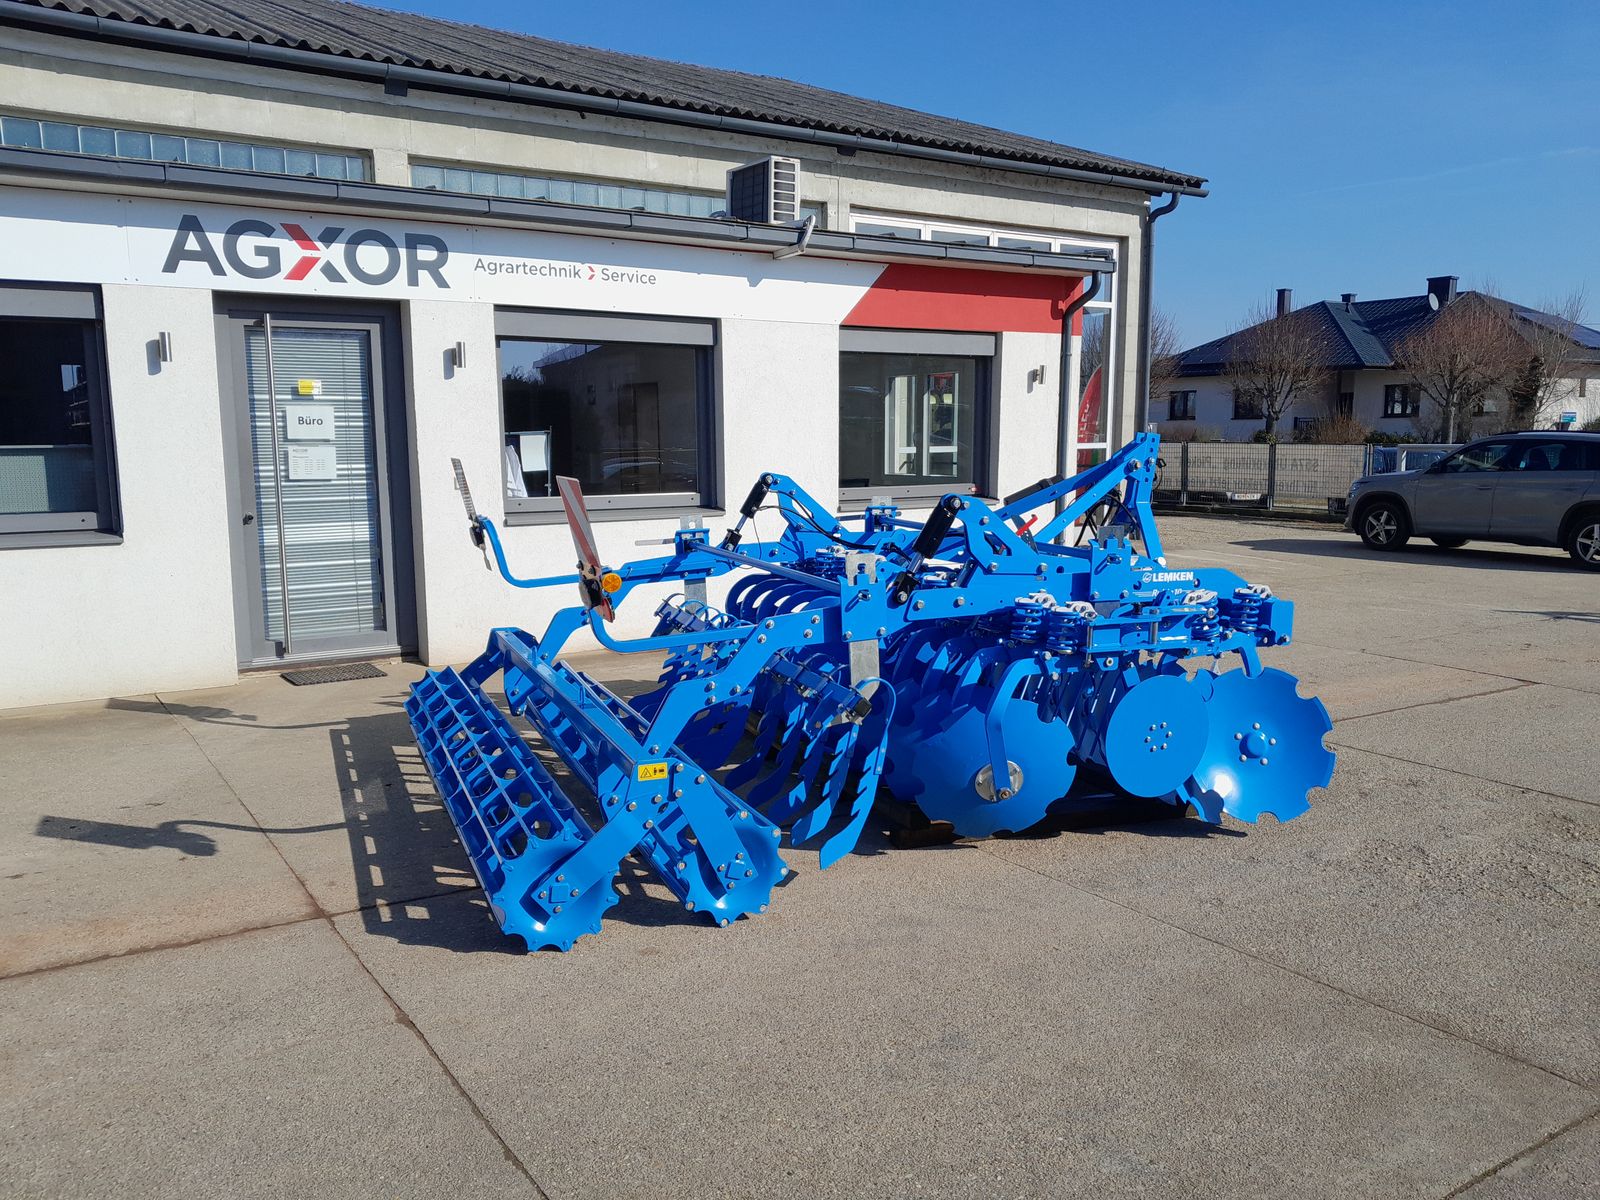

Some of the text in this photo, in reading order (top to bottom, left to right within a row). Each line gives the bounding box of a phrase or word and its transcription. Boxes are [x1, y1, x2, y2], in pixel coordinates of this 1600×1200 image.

[161, 214, 451, 289] AGXOR
[474, 258, 657, 285] Agrartechnik Service
[297, 415, 324, 426] Büro
[1152, 571, 1194, 582] LEMKEN
